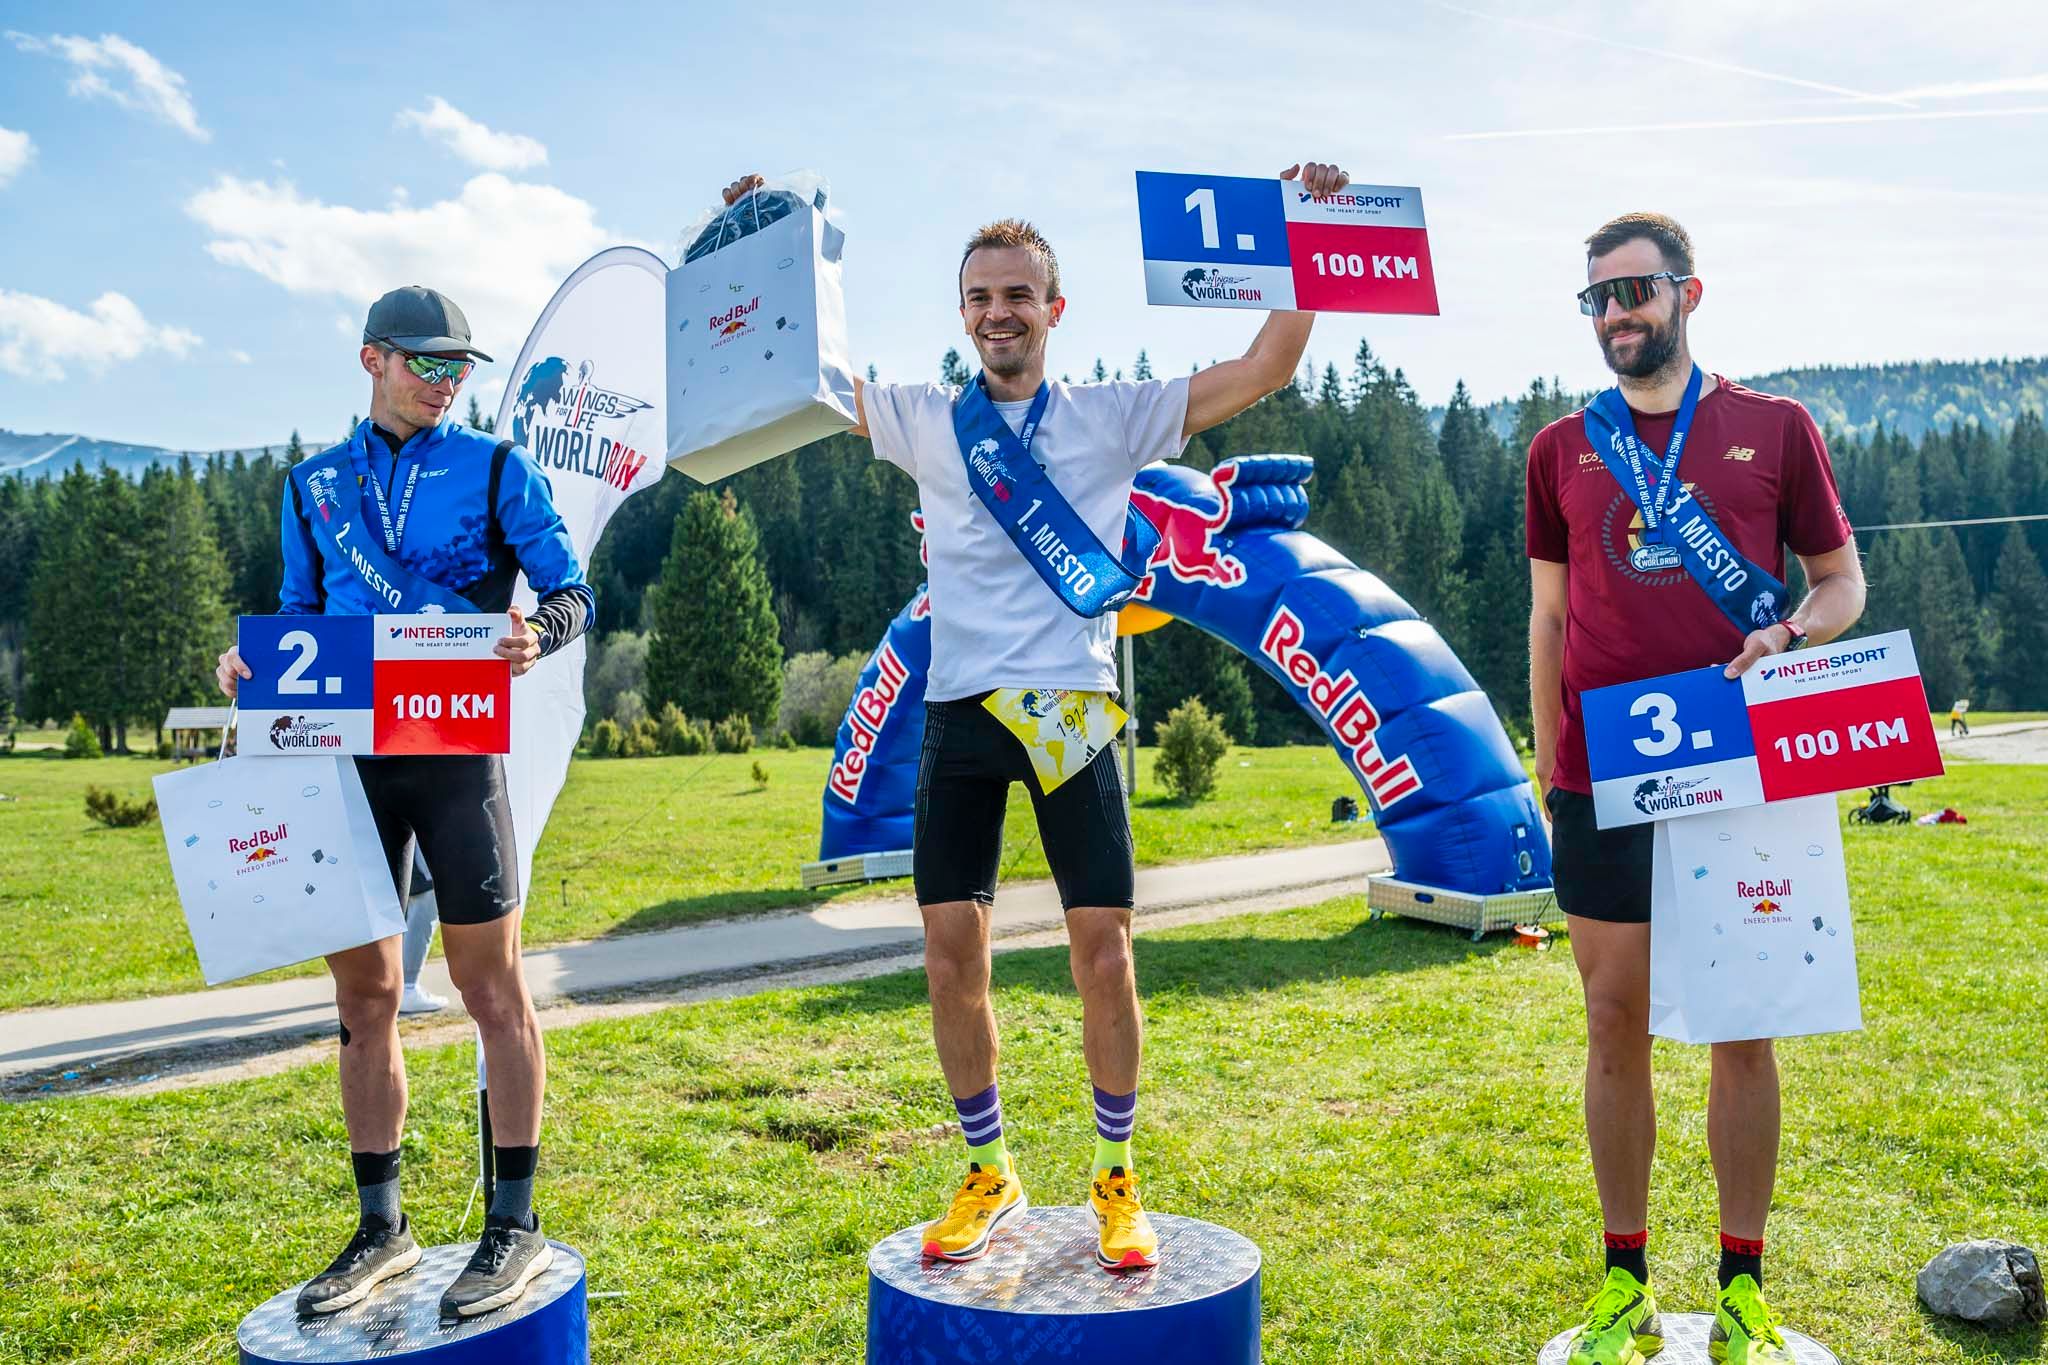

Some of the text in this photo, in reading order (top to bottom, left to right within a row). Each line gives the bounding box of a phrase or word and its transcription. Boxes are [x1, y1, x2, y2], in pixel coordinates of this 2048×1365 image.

[1312, 194, 1402, 208] INTERSPORT
[1184, 188, 1256, 251] 1.
[1312, 252, 1419, 280] 100 KM
[562, 385, 619, 415] WINGS
[556, 407, 600, 432] FOR LIFE
[535, 424, 612, 480] WORLD
[1669, 431, 1685, 455] WINGS
[407, 463, 420, 485] WINGS
[972, 453, 999, 488] WORLD
[1628, 450, 1644, 475] WORLD
[1664, 454, 1677, 469] FOR
[1635, 474, 1649, 490] LIFE
[1660, 469, 1673, 485] LIFE
[308, 477, 326, 508] WORLD
[403, 485, 414, 500] FOR
[1639, 490, 1652, 505] FOR
[1665, 486, 1692, 525] 3.
[399, 499, 411, 513] LIFE
[1015, 498, 1043, 533] 1.
[1643, 505, 1658, 529] WINGS
[335, 521, 350, 555] 2.
[404, 626, 492, 639] INTERSPORT
[277, 629, 343, 696] 2.
[1777, 647, 1888, 678] INTERSPORT
[1808, 674, 1830, 682] HEART
[1841, 667, 1863, 676] SPORT
[392, 693, 495, 719] 100 KM
[1056, 699, 1089, 737] 1914
[1262, 609, 1420, 808] Red Bull
[830, 643, 909, 802] Red Bull
[1629, 692, 1714, 757] 3.
[281, 735, 342, 748] WORLD RUN
[1774, 717, 1910, 763] 100 KM
[1648, 788, 1724, 812] WORLD RUN
[229, 823, 288, 854] Red Bull
[1737, 878, 1792, 898] Red Bull
